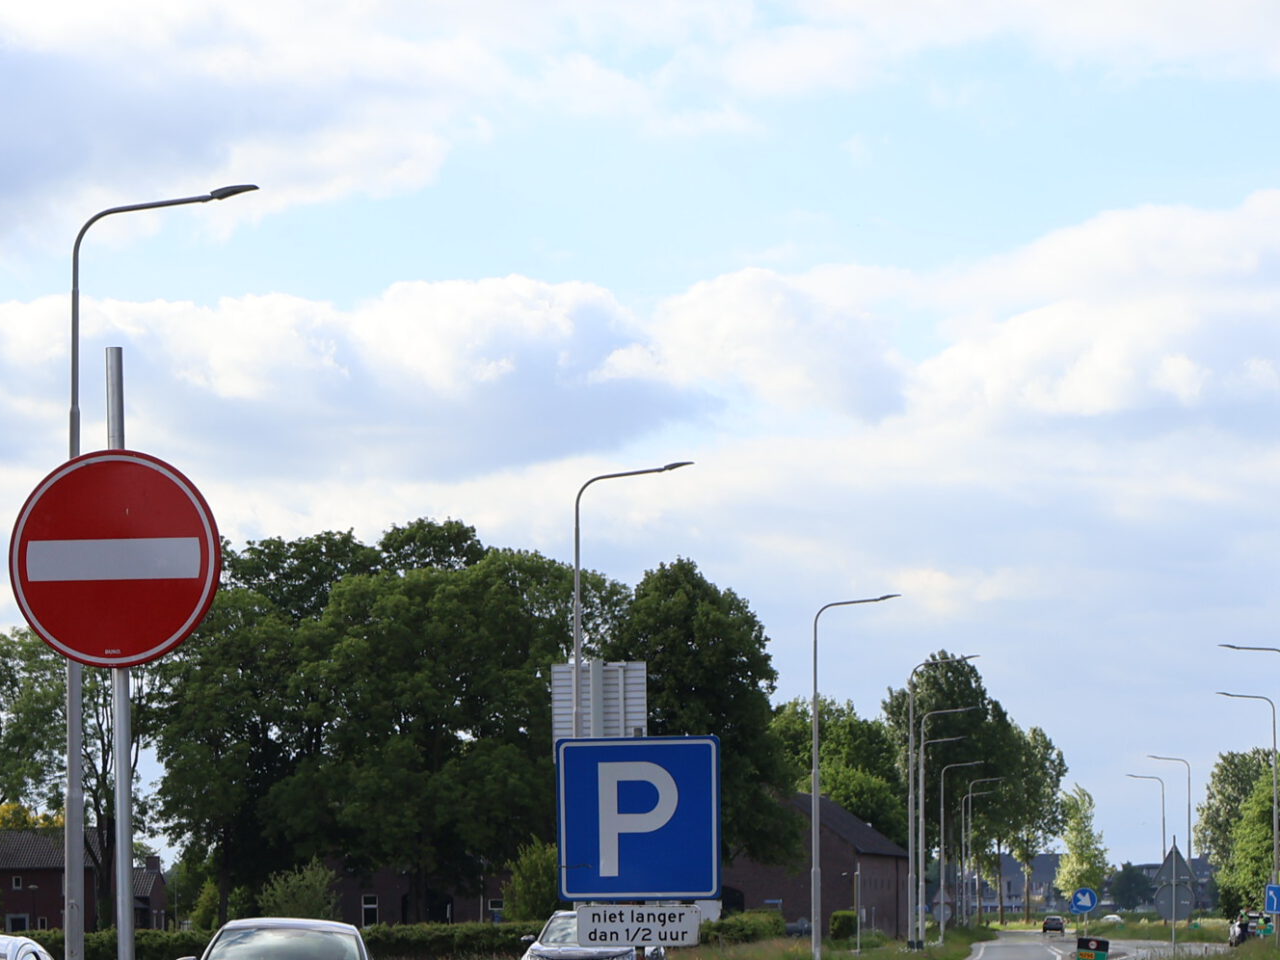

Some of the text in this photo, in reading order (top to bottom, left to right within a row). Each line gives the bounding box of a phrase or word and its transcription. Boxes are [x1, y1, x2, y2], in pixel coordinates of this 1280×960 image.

[598, 761, 679, 877] P
[592, 910, 685, 926] niet langer
[588, 928, 688, 942] dan 1/2 uur
